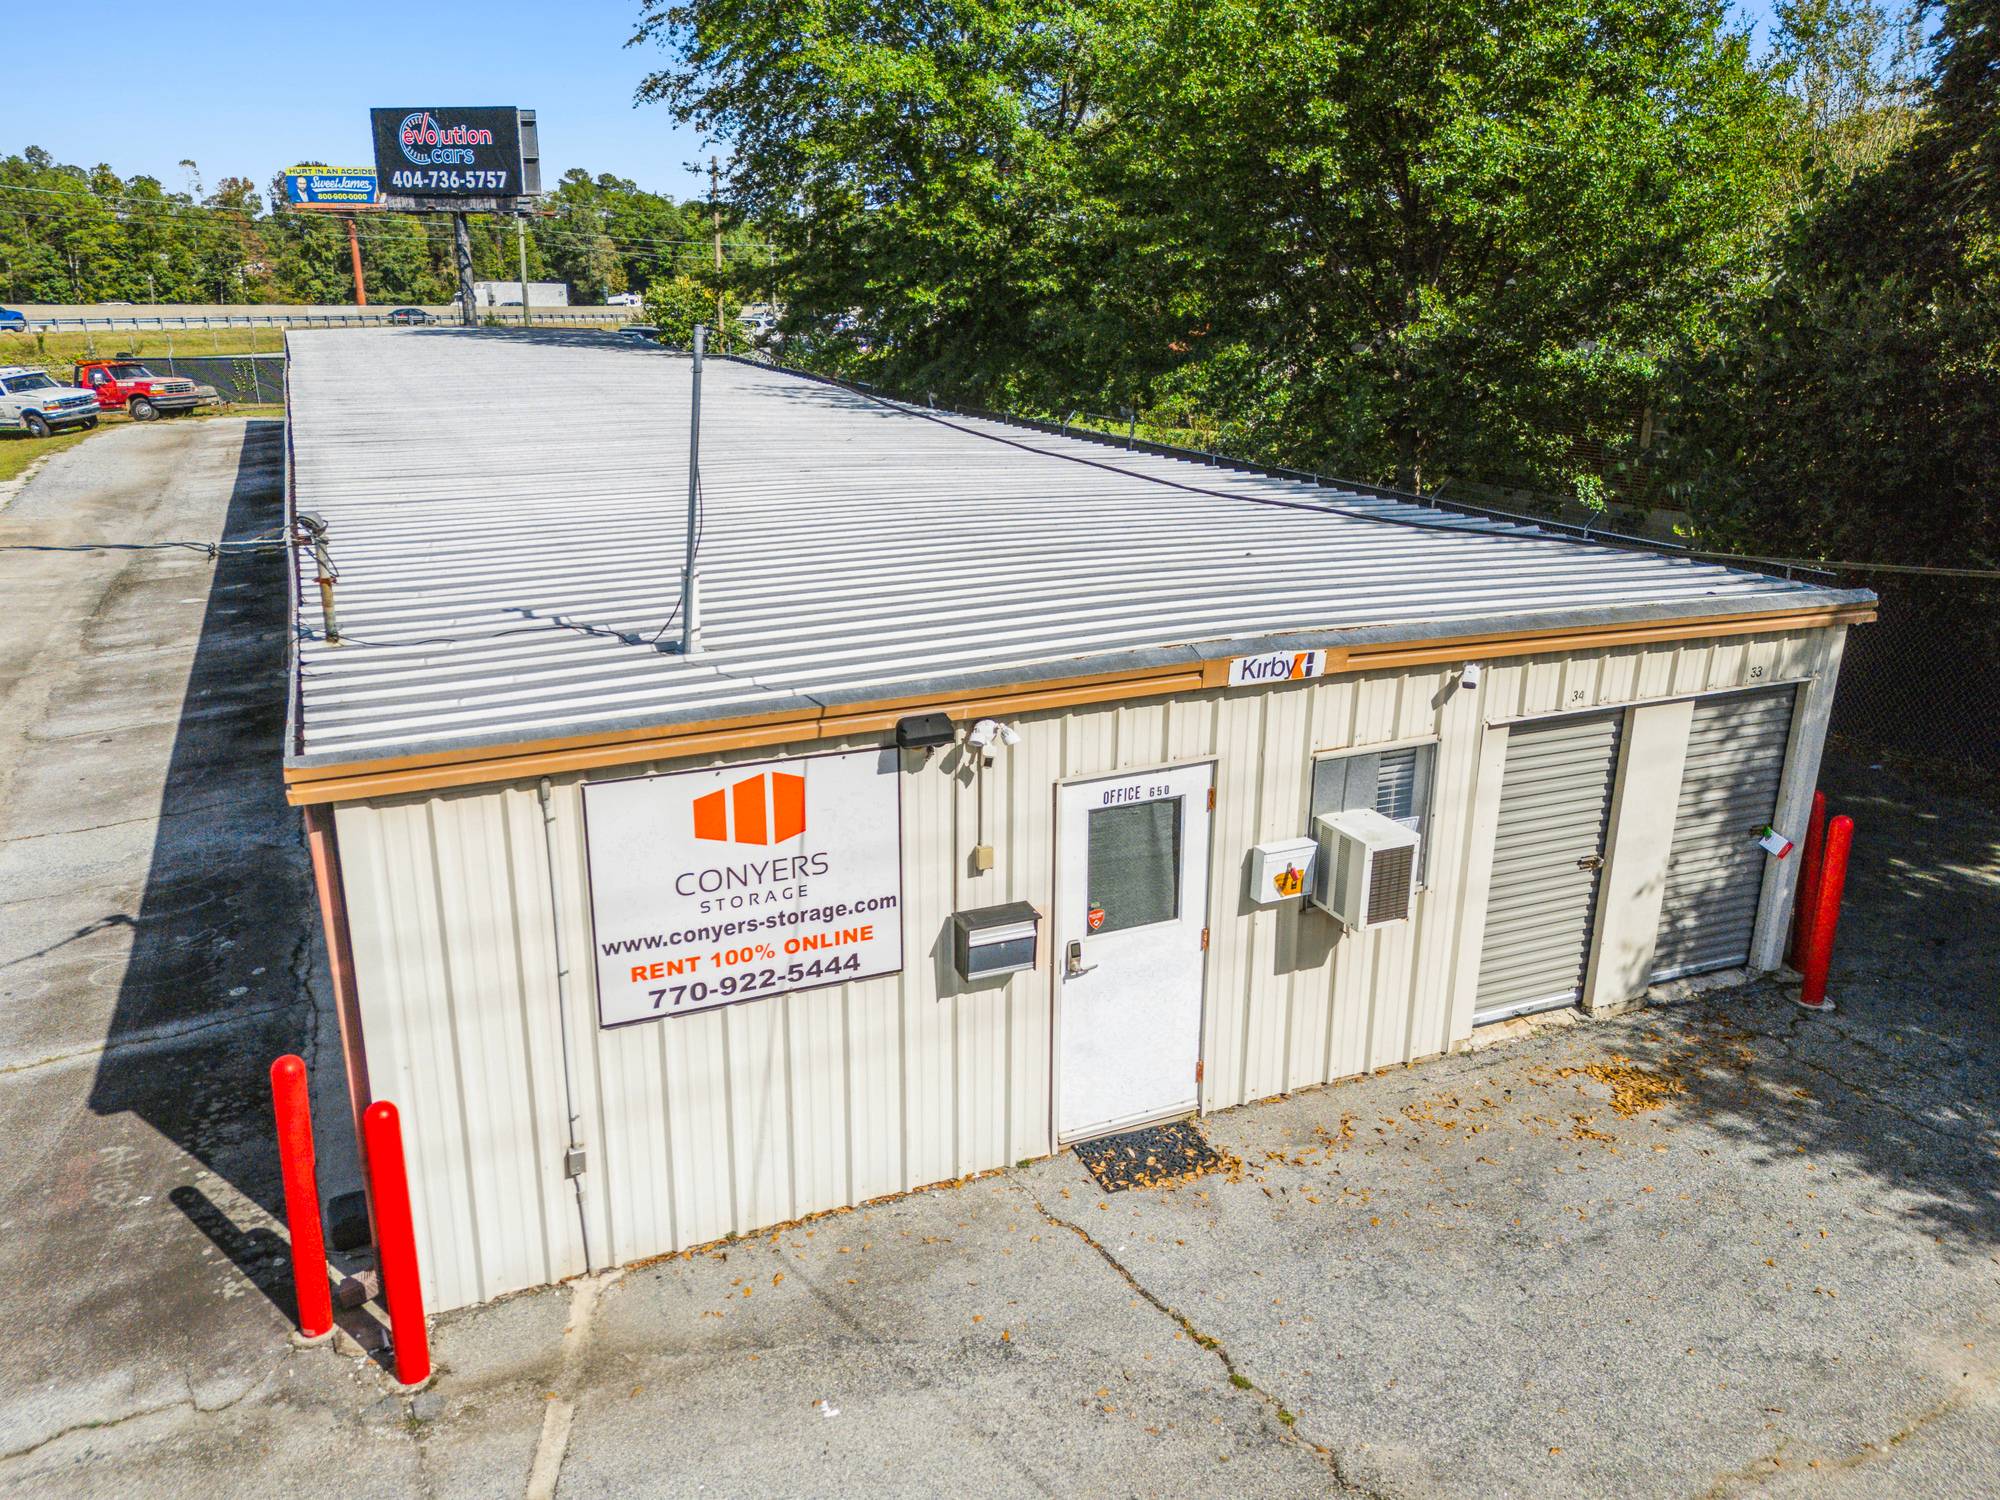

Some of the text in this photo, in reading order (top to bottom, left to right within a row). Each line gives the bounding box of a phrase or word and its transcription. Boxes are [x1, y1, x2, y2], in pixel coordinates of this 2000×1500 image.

[431, 148, 475, 165] cars
[392, 170, 507, 189] 404-736-5757
[1241, 657, 1298, 680] Kirby
[1750, 665, 1763, 678] 33
[1572, 690, 1585, 702] 34
[1103, 784, 1170, 805] OFFICE 650
[675, 852, 829, 896] CONYERS
[700, 885, 808, 914] STORAGE
[602, 895, 897, 956] www.conyers-storage.com
[631, 925, 874, 983] RENT 100% ONLINE
[649, 952, 861, 1010] 770-922-5444
